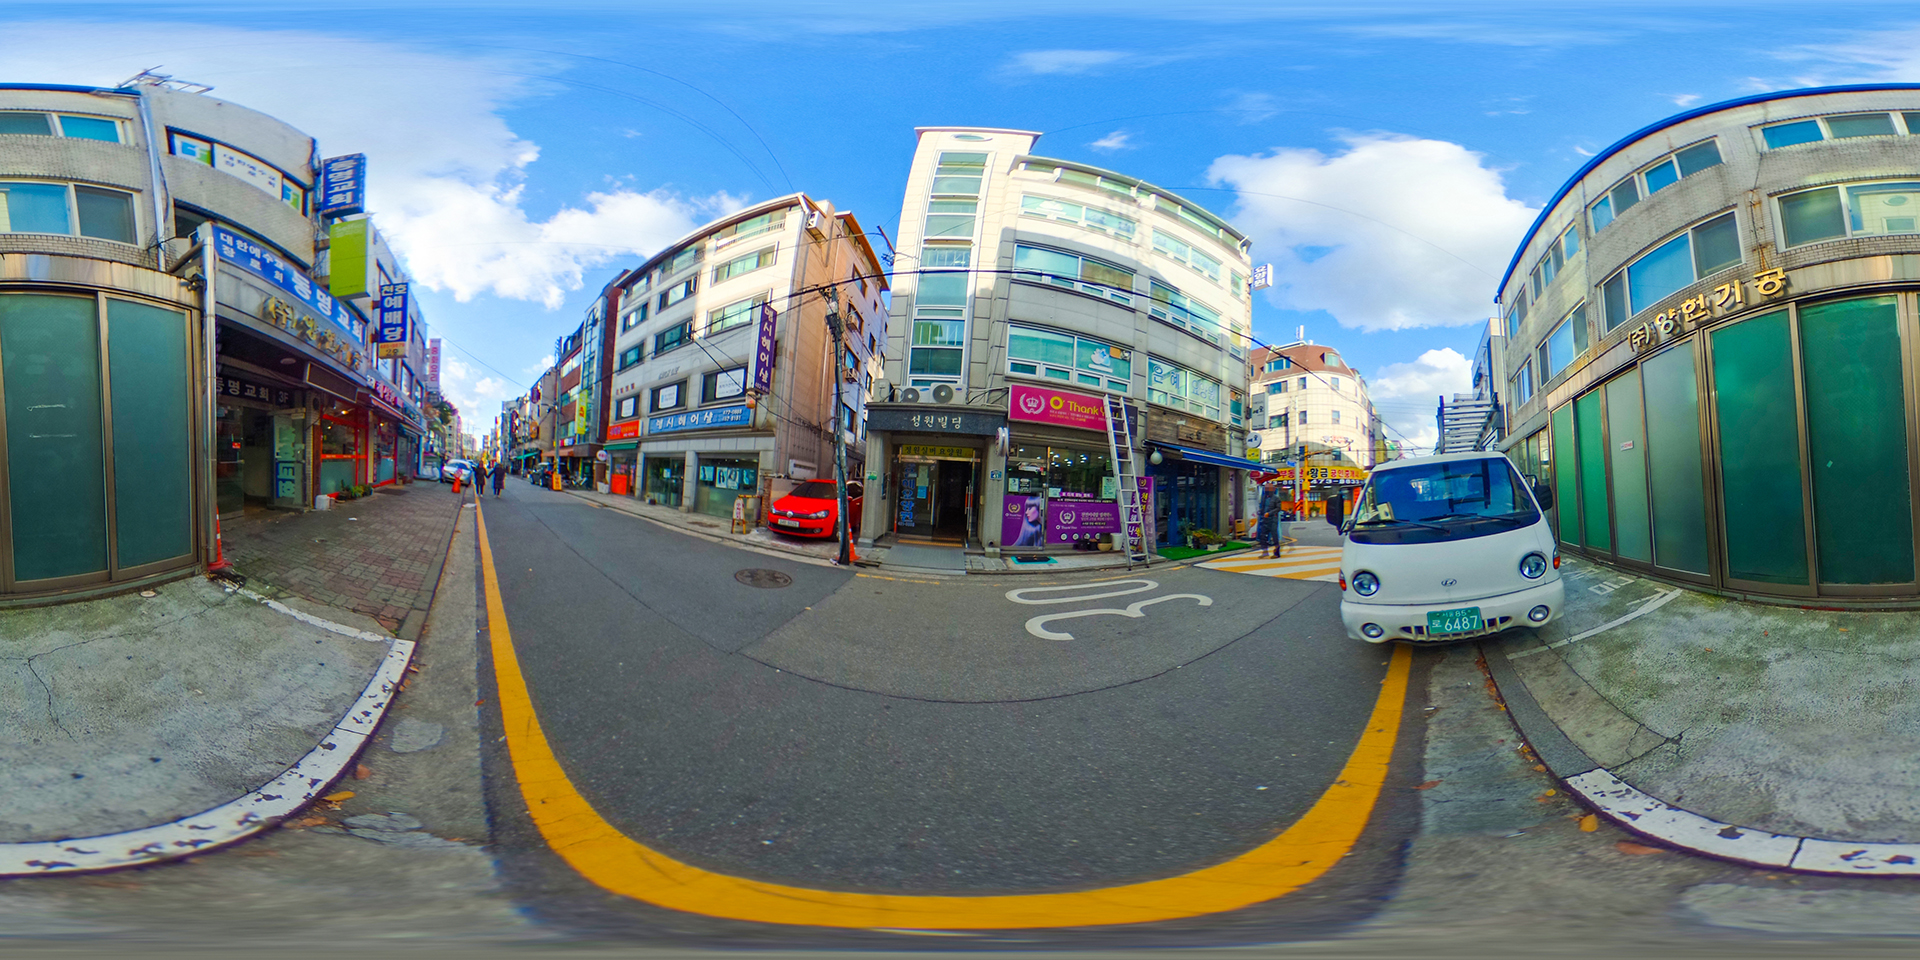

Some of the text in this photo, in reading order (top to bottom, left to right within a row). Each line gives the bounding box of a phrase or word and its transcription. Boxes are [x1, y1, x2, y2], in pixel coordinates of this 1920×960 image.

[327, 160, 358, 206] 동명교회
[219, 232, 284, 271] 대한예수교
[221, 244, 284, 283] 장로회
[291, 270, 363, 343] 동명교회
[383, 296, 404, 341] 예배당
[1153, 364, 1180, 389] 은혜
[910, 414, 962, 430] 성원빌딩
[1068, 400, 1099, 416] Thank
[1005, 579, 1214, 641] 30
[1444, 615, 1478, 631] 6487
[1455, 609, 1467, 617] 85
